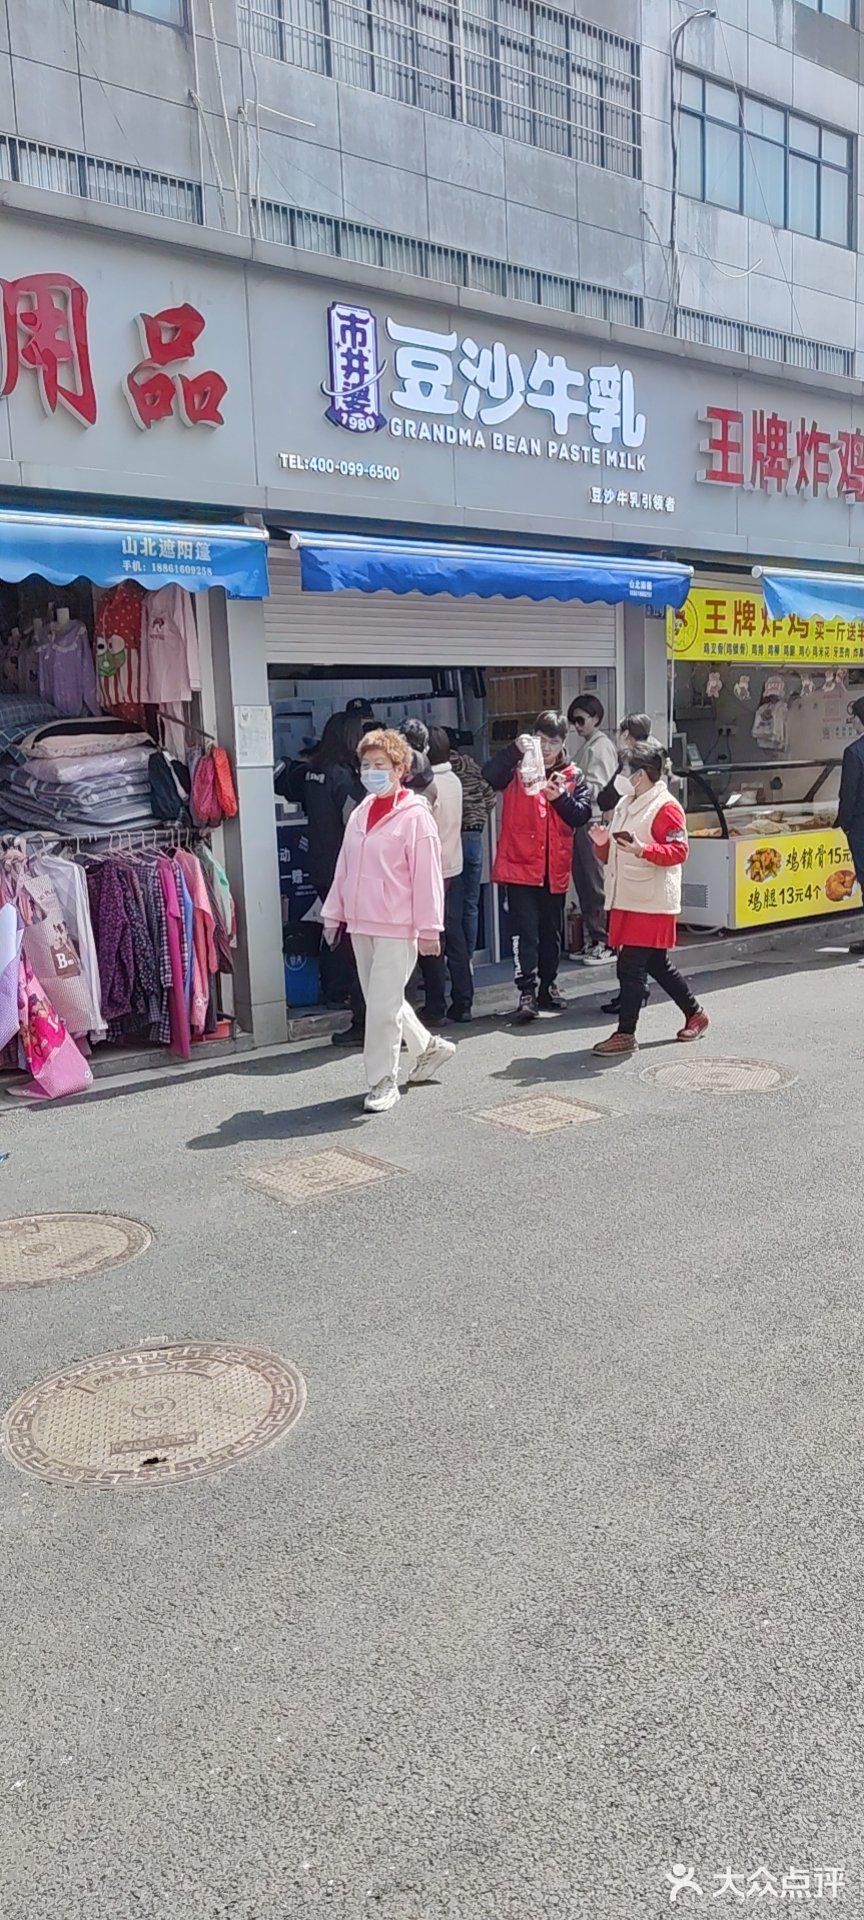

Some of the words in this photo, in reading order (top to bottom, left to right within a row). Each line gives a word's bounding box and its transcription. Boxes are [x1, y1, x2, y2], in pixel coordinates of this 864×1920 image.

[0, 273, 228, 431] 用品
[386, 316, 647, 449] 豆沙牛乳
[340, 411, 376, 431] 1980
[389, 417, 486, 449] GRANDMA
[491, 432, 541, 456] BEAN
[548, 441, 600, 465] PASTE
[604, 450, 647, 472] MILK
[698, 406, 864, 503] 王牌炸鸡
[279, 452, 400, 481] TEL:400-099-6500
[589, 486, 676, 513] 豆沙牛乳引领者
[786, 844, 854, 872] 鸡锁骨15元
